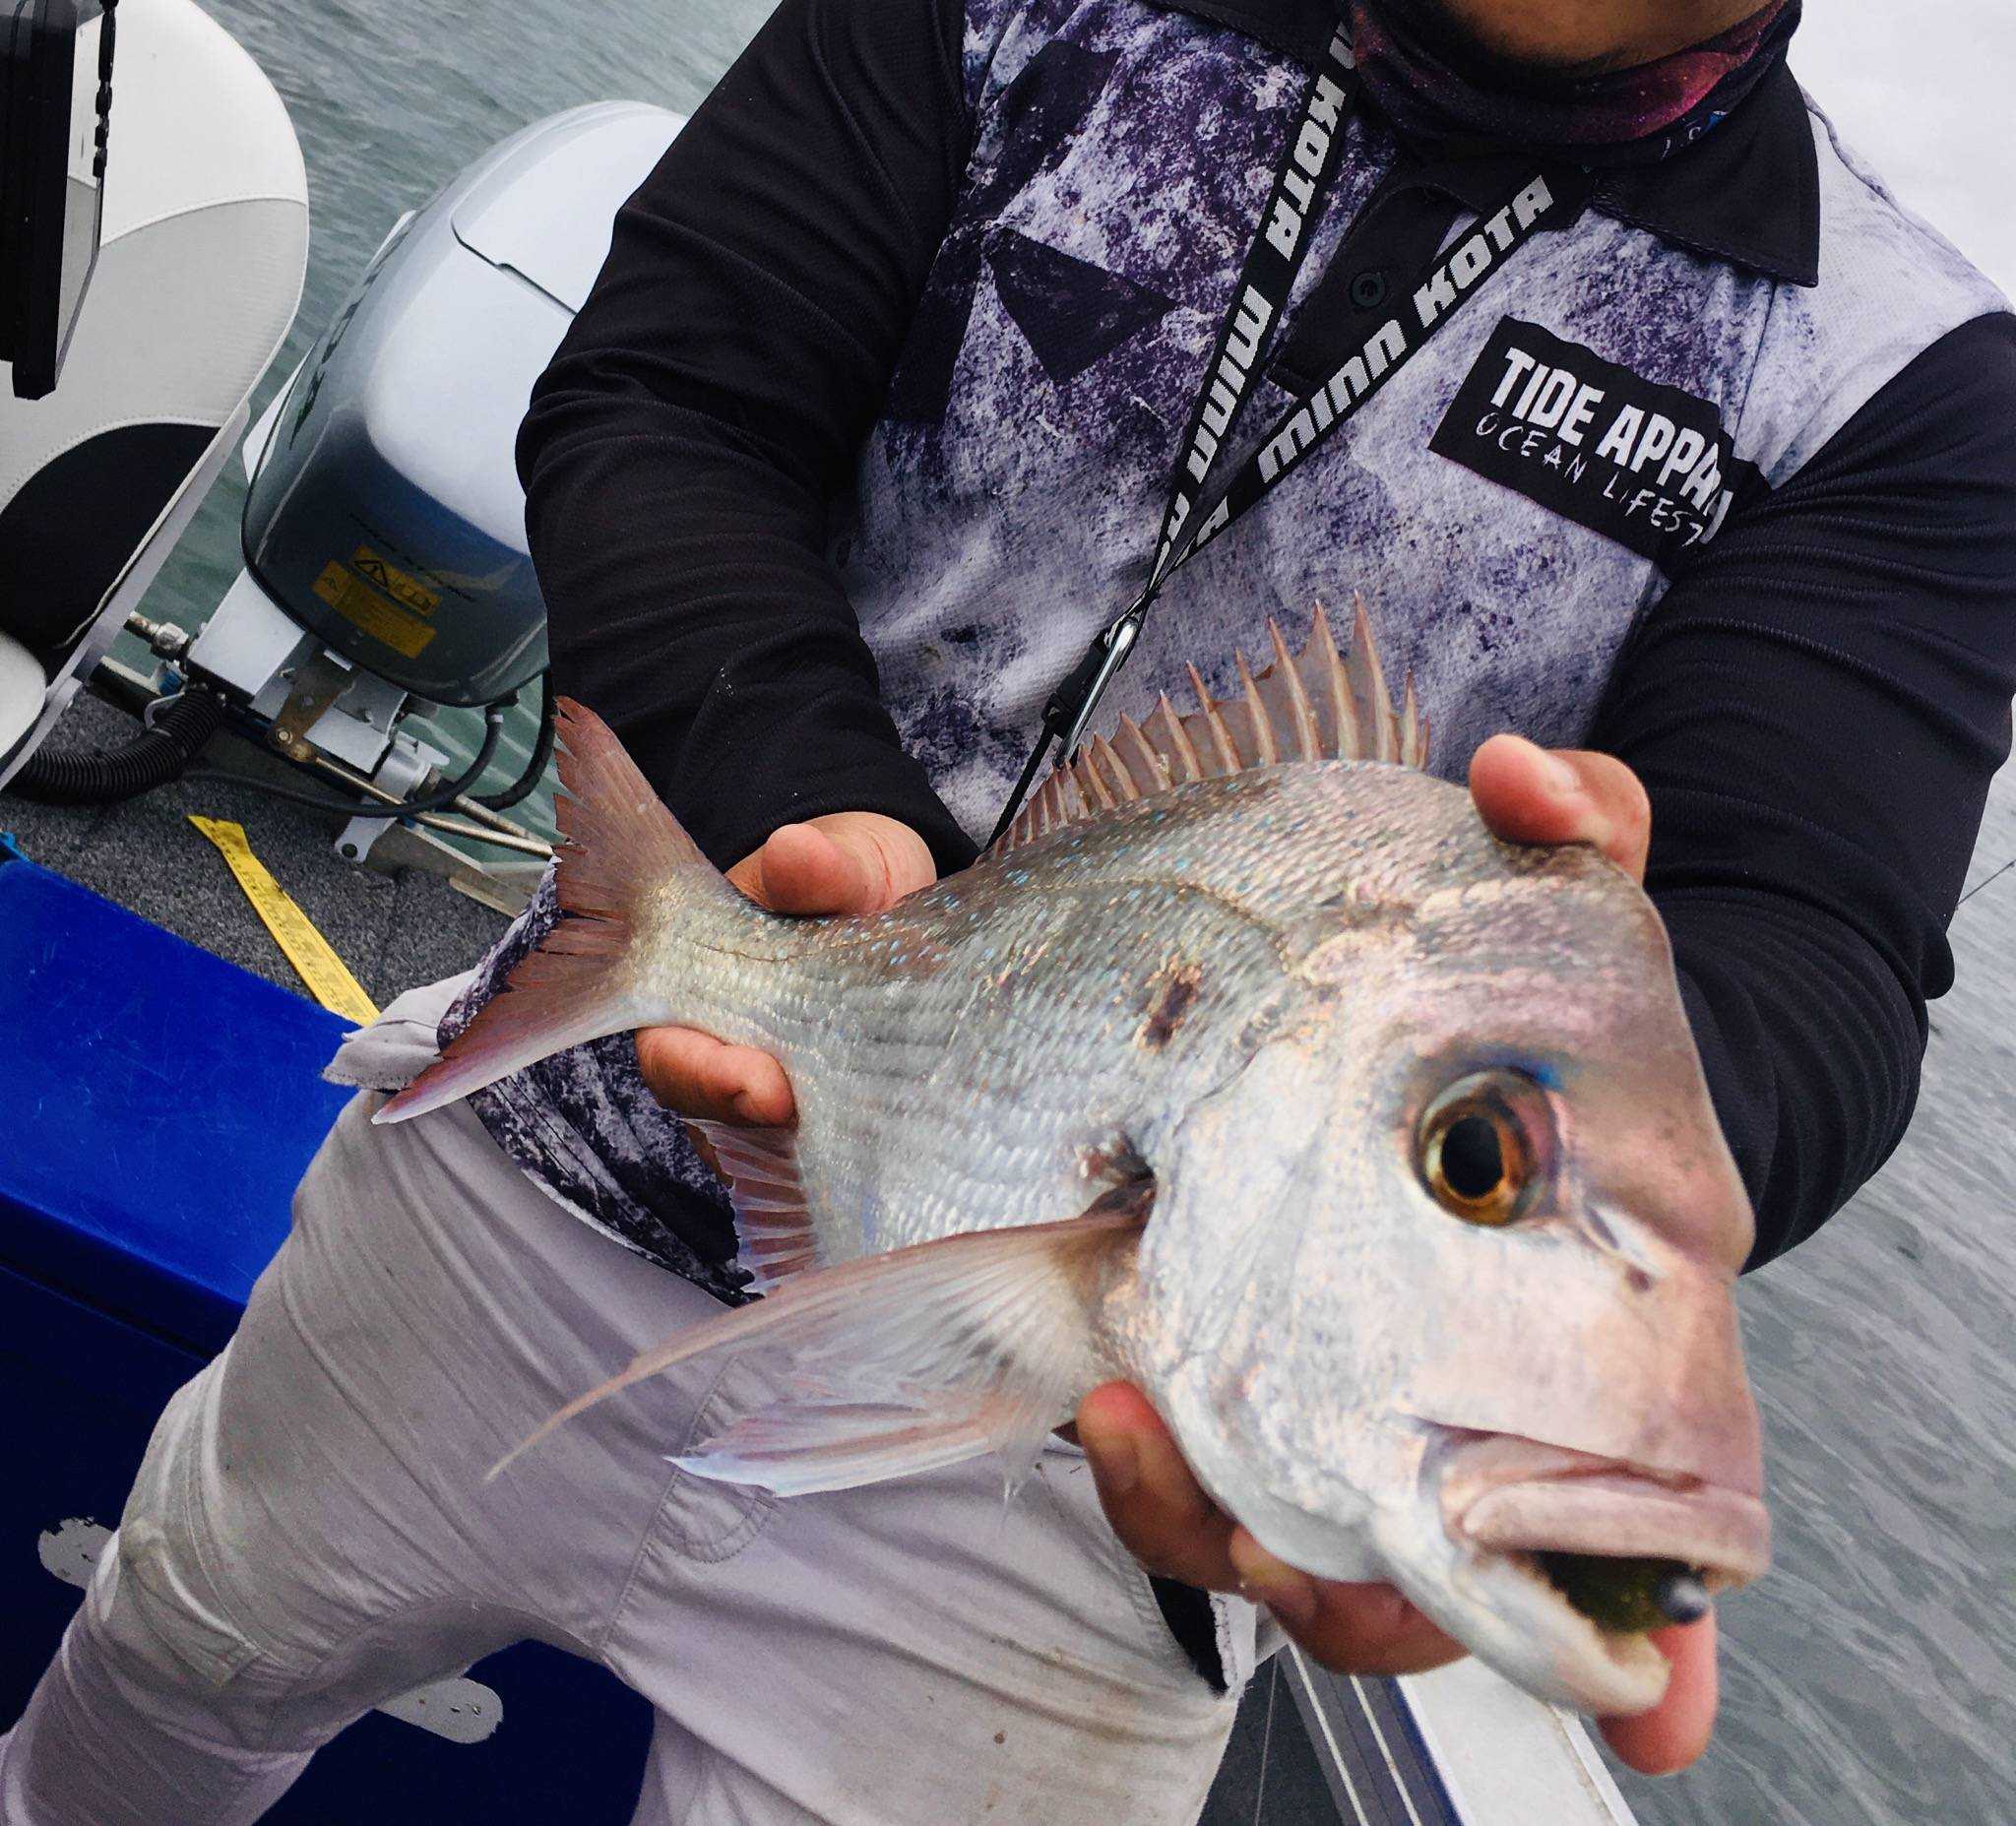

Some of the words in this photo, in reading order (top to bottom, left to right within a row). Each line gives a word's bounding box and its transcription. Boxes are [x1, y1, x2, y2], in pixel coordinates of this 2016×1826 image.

[1266, 74, 1346, 262] KOTA
[1413, 175, 1553, 328] KOTA
[1476, 411, 1588, 483] OCEAN
[1490, 346, 1605, 446] TIDE
